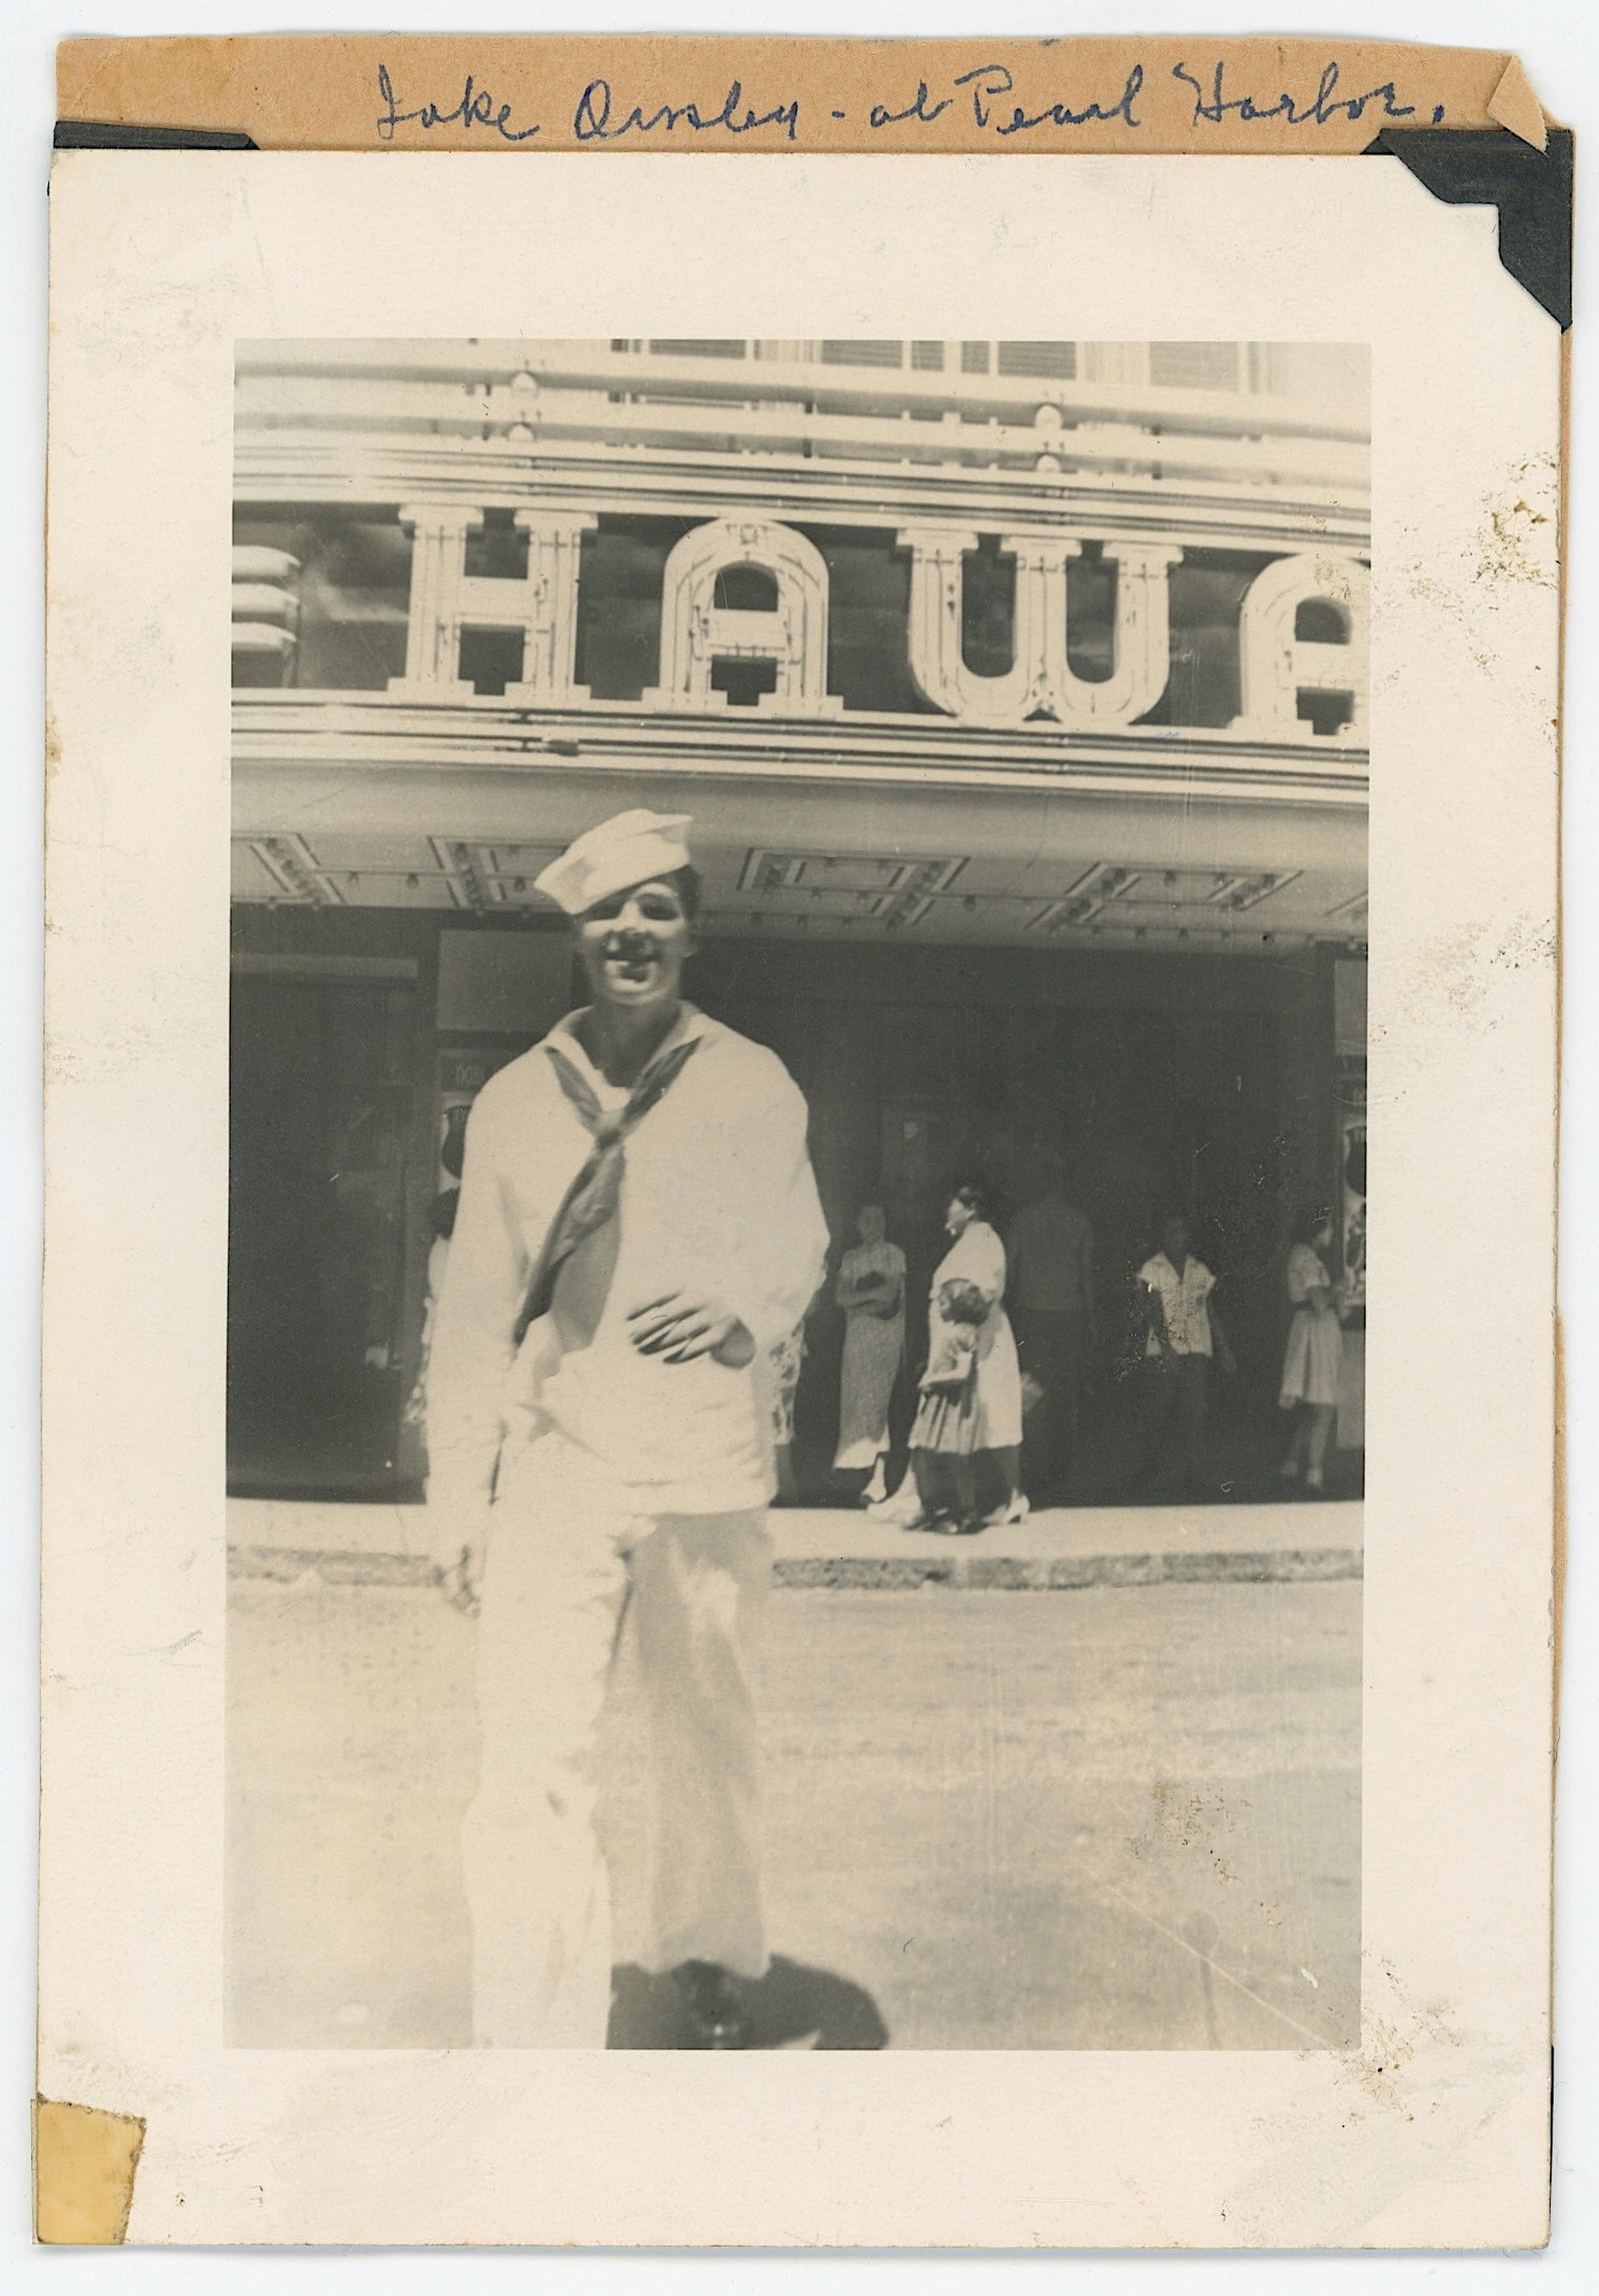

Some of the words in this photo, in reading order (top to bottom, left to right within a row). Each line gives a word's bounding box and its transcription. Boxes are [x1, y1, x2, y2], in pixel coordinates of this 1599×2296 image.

[376, 63, 542, 141] Jake
[954, 63, 1142, 136] Pearl
[387, 504, 1370, 745] HAWA
